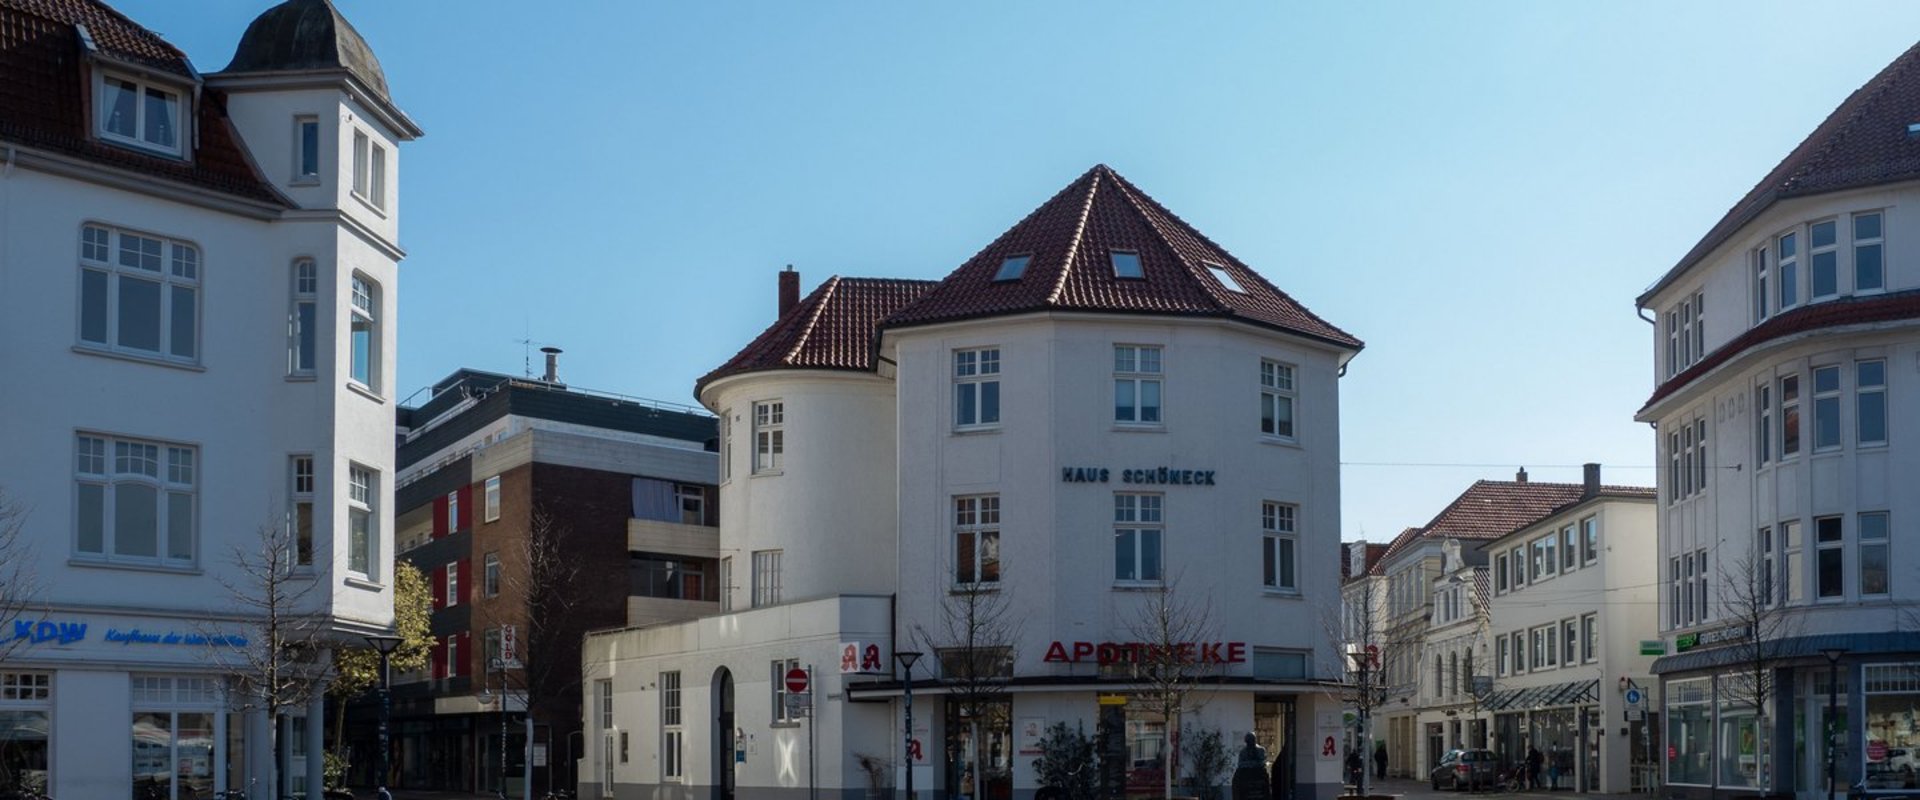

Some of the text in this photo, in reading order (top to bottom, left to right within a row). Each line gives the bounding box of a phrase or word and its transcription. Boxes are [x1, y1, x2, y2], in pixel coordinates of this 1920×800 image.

[1062, 466, 1216, 486] HAUS SCHÖNECK
[14, 619, 88, 645] KDW
[104, 628, 161, 645] Kaufhaus
[162, 631, 182, 645] der
[1044, 640, 1246, 666] APOTHEKE
